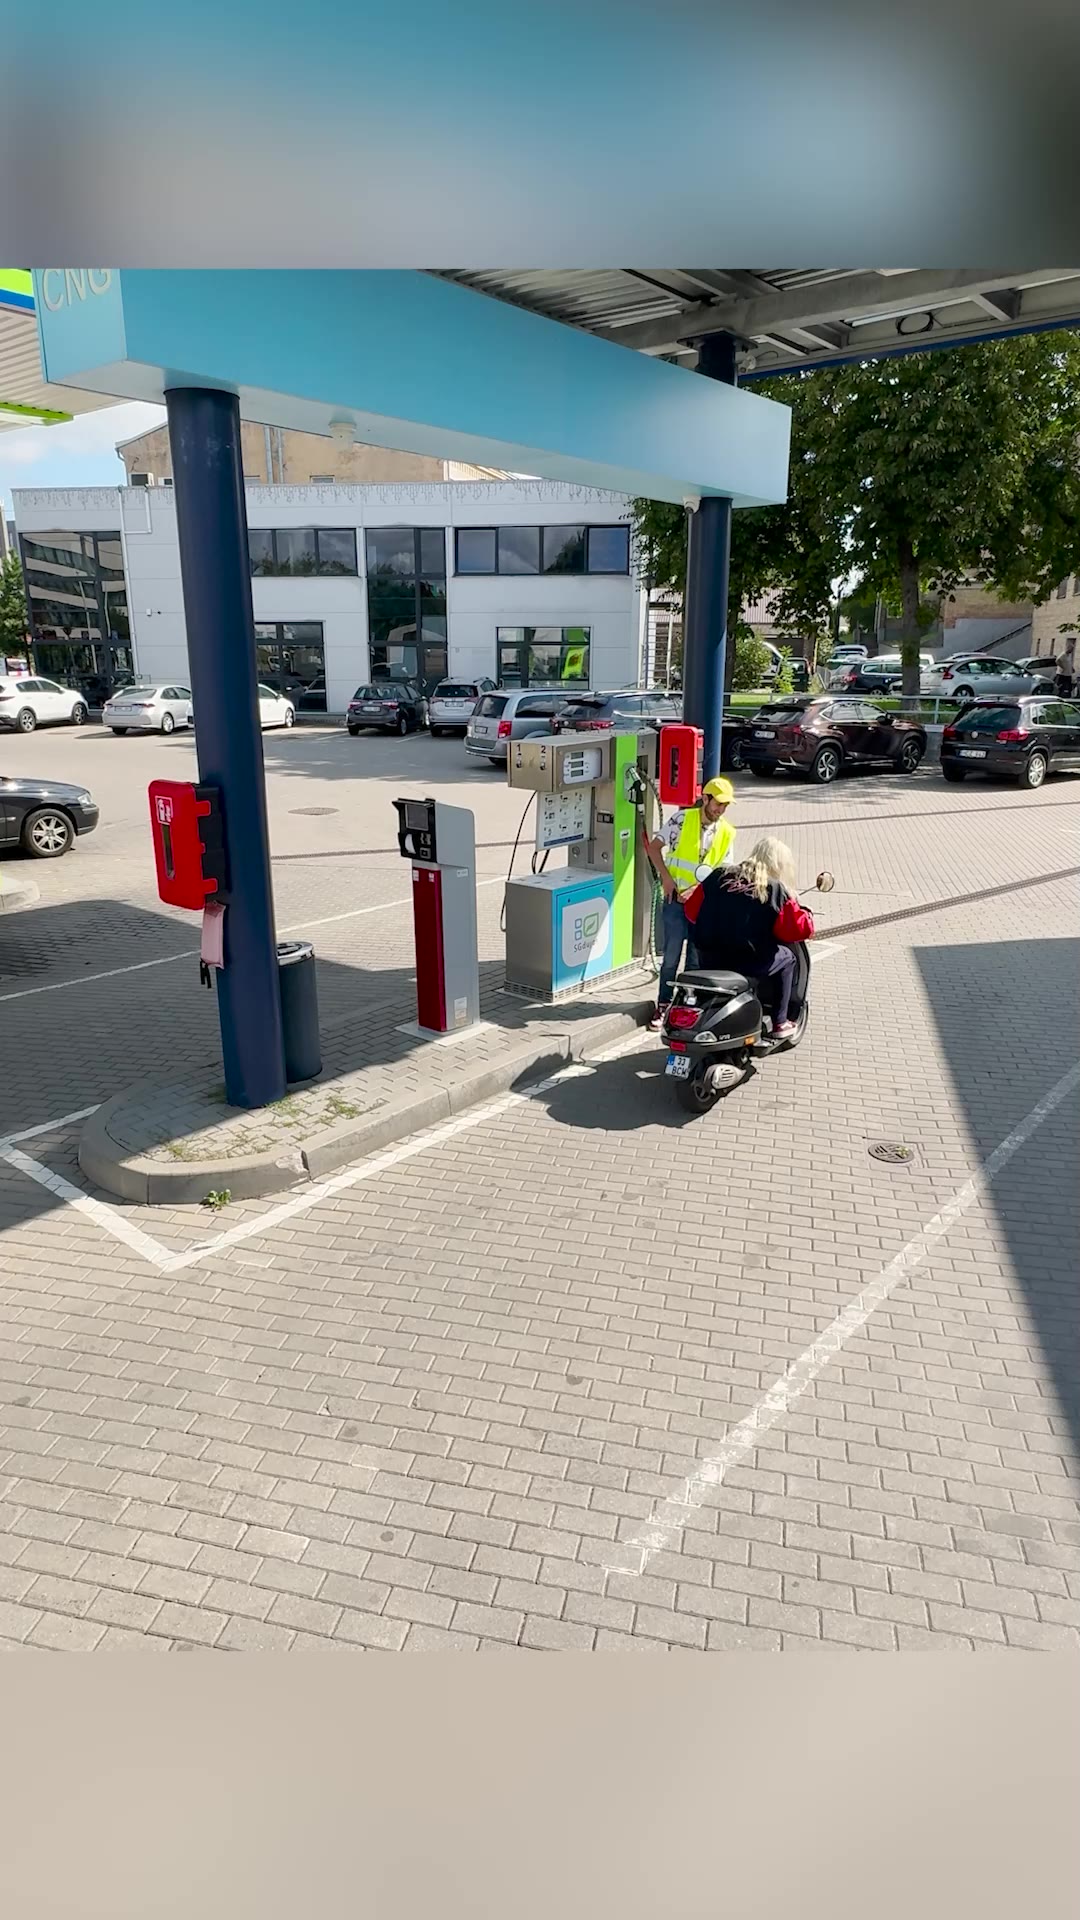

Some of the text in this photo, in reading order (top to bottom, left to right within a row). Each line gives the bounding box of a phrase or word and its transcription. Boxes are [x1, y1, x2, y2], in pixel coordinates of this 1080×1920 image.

[43, 268, 112, 312] CNG
[516, 743, 521, 752] 1
[541, 745, 547, 754] 2
[573, 939, 597, 953] SGduj
